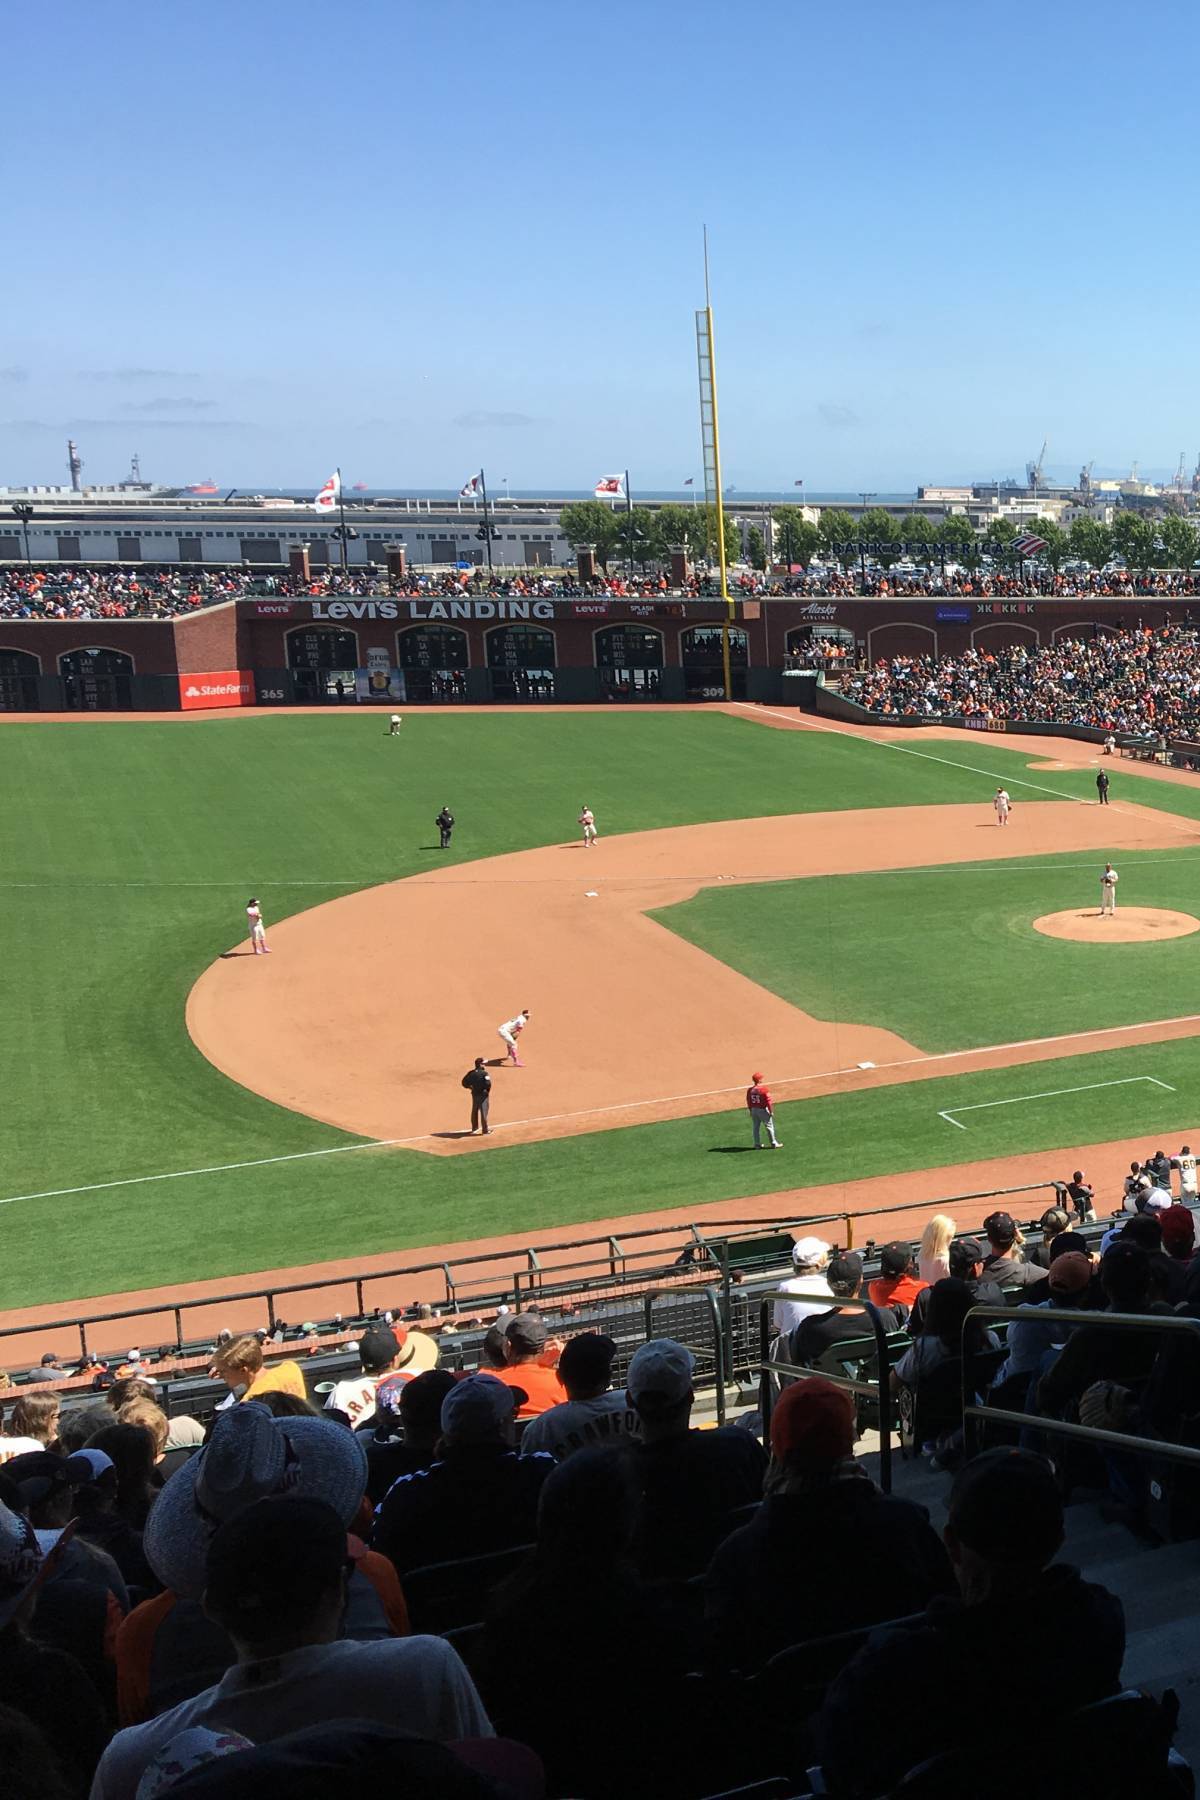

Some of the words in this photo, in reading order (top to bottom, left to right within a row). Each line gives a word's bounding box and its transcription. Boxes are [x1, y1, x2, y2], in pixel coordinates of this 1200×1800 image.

[832, 542, 882, 554] BANK
[891, 542, 914, 554] OF
[920, 542, 1005, 554] AMERICA
[410, 601, 554, 619] LANDING
[800, 602, 837, 615] Alaska
[261, 689, 285, 699] 365
[702, 687, 725, 697] 309
[965, 719, 987, 729] KNBR
[988, 720, 1005, 730] 680
